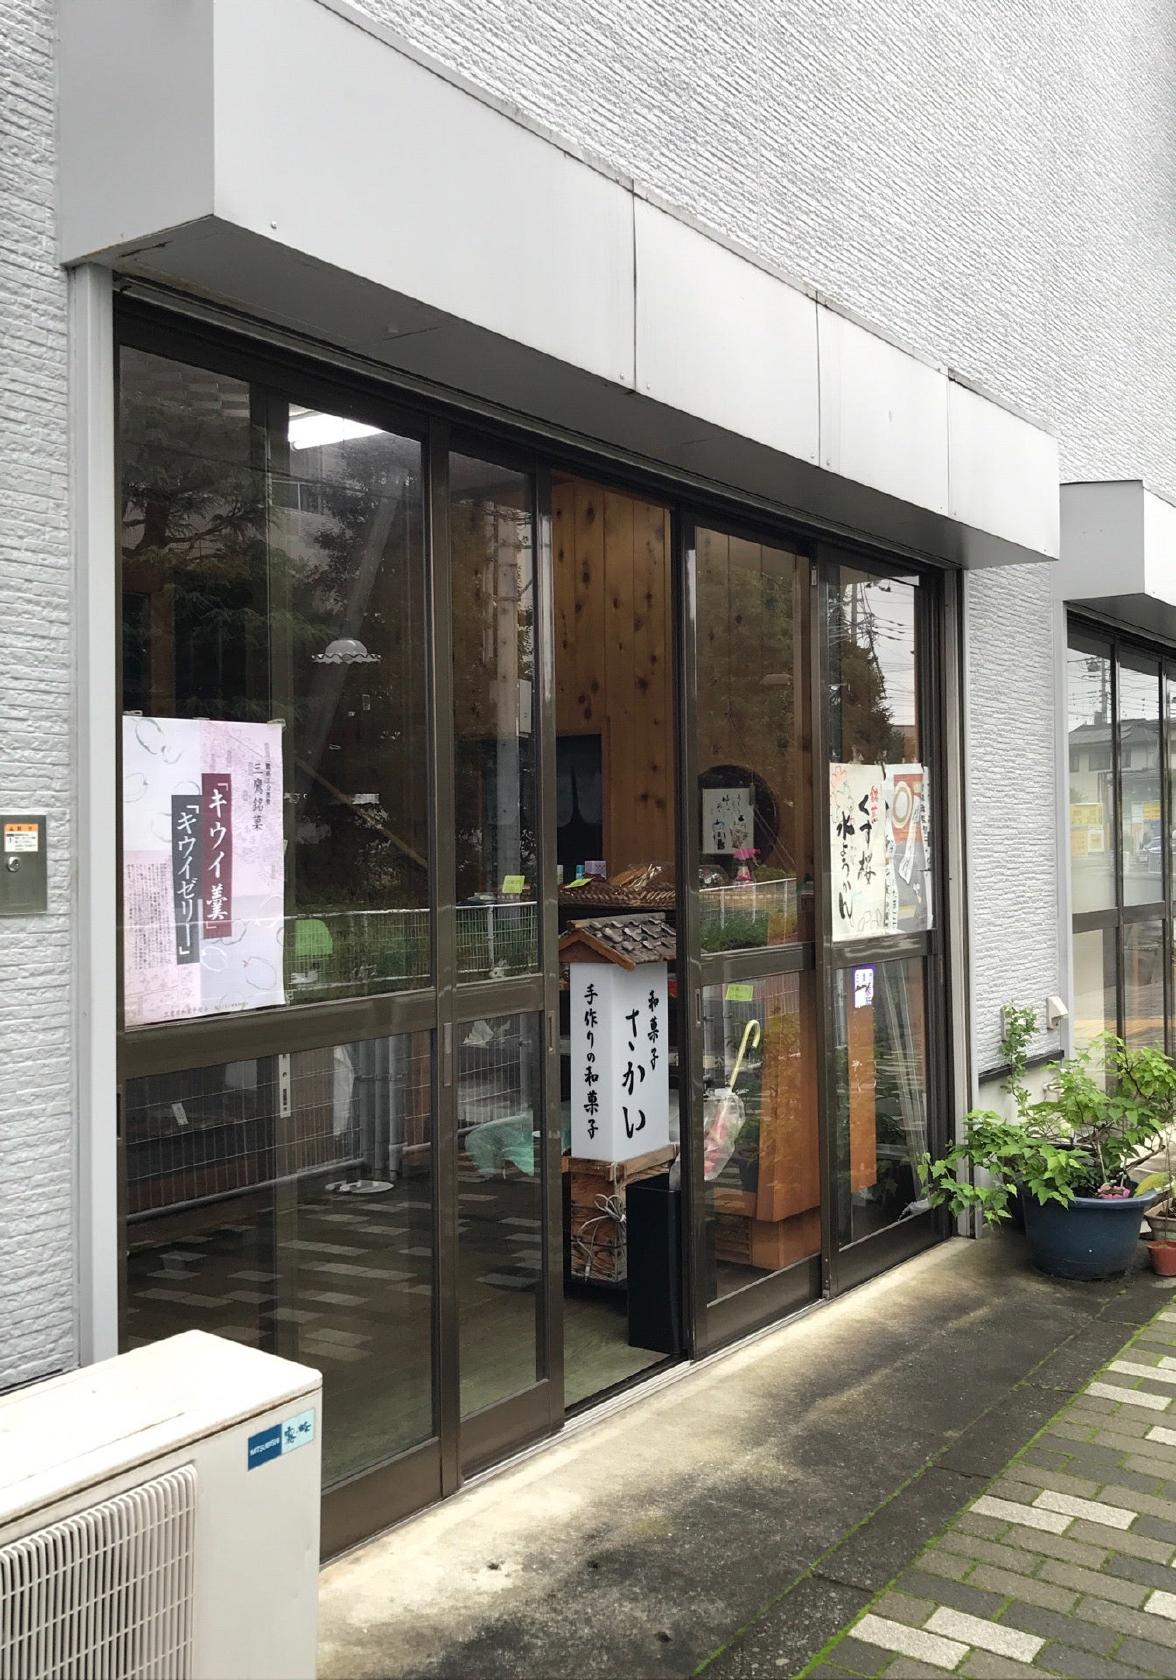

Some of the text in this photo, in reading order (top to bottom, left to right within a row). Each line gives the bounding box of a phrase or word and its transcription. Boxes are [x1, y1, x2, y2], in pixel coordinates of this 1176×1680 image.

[176, 805, 200, 955] 「キウイゼリー」
[583, 983, 600, 1140] 手作りの和菓子
[622, 1008, 646, 1139] さかい
[647, 989, 660, 1071] 和菓子
